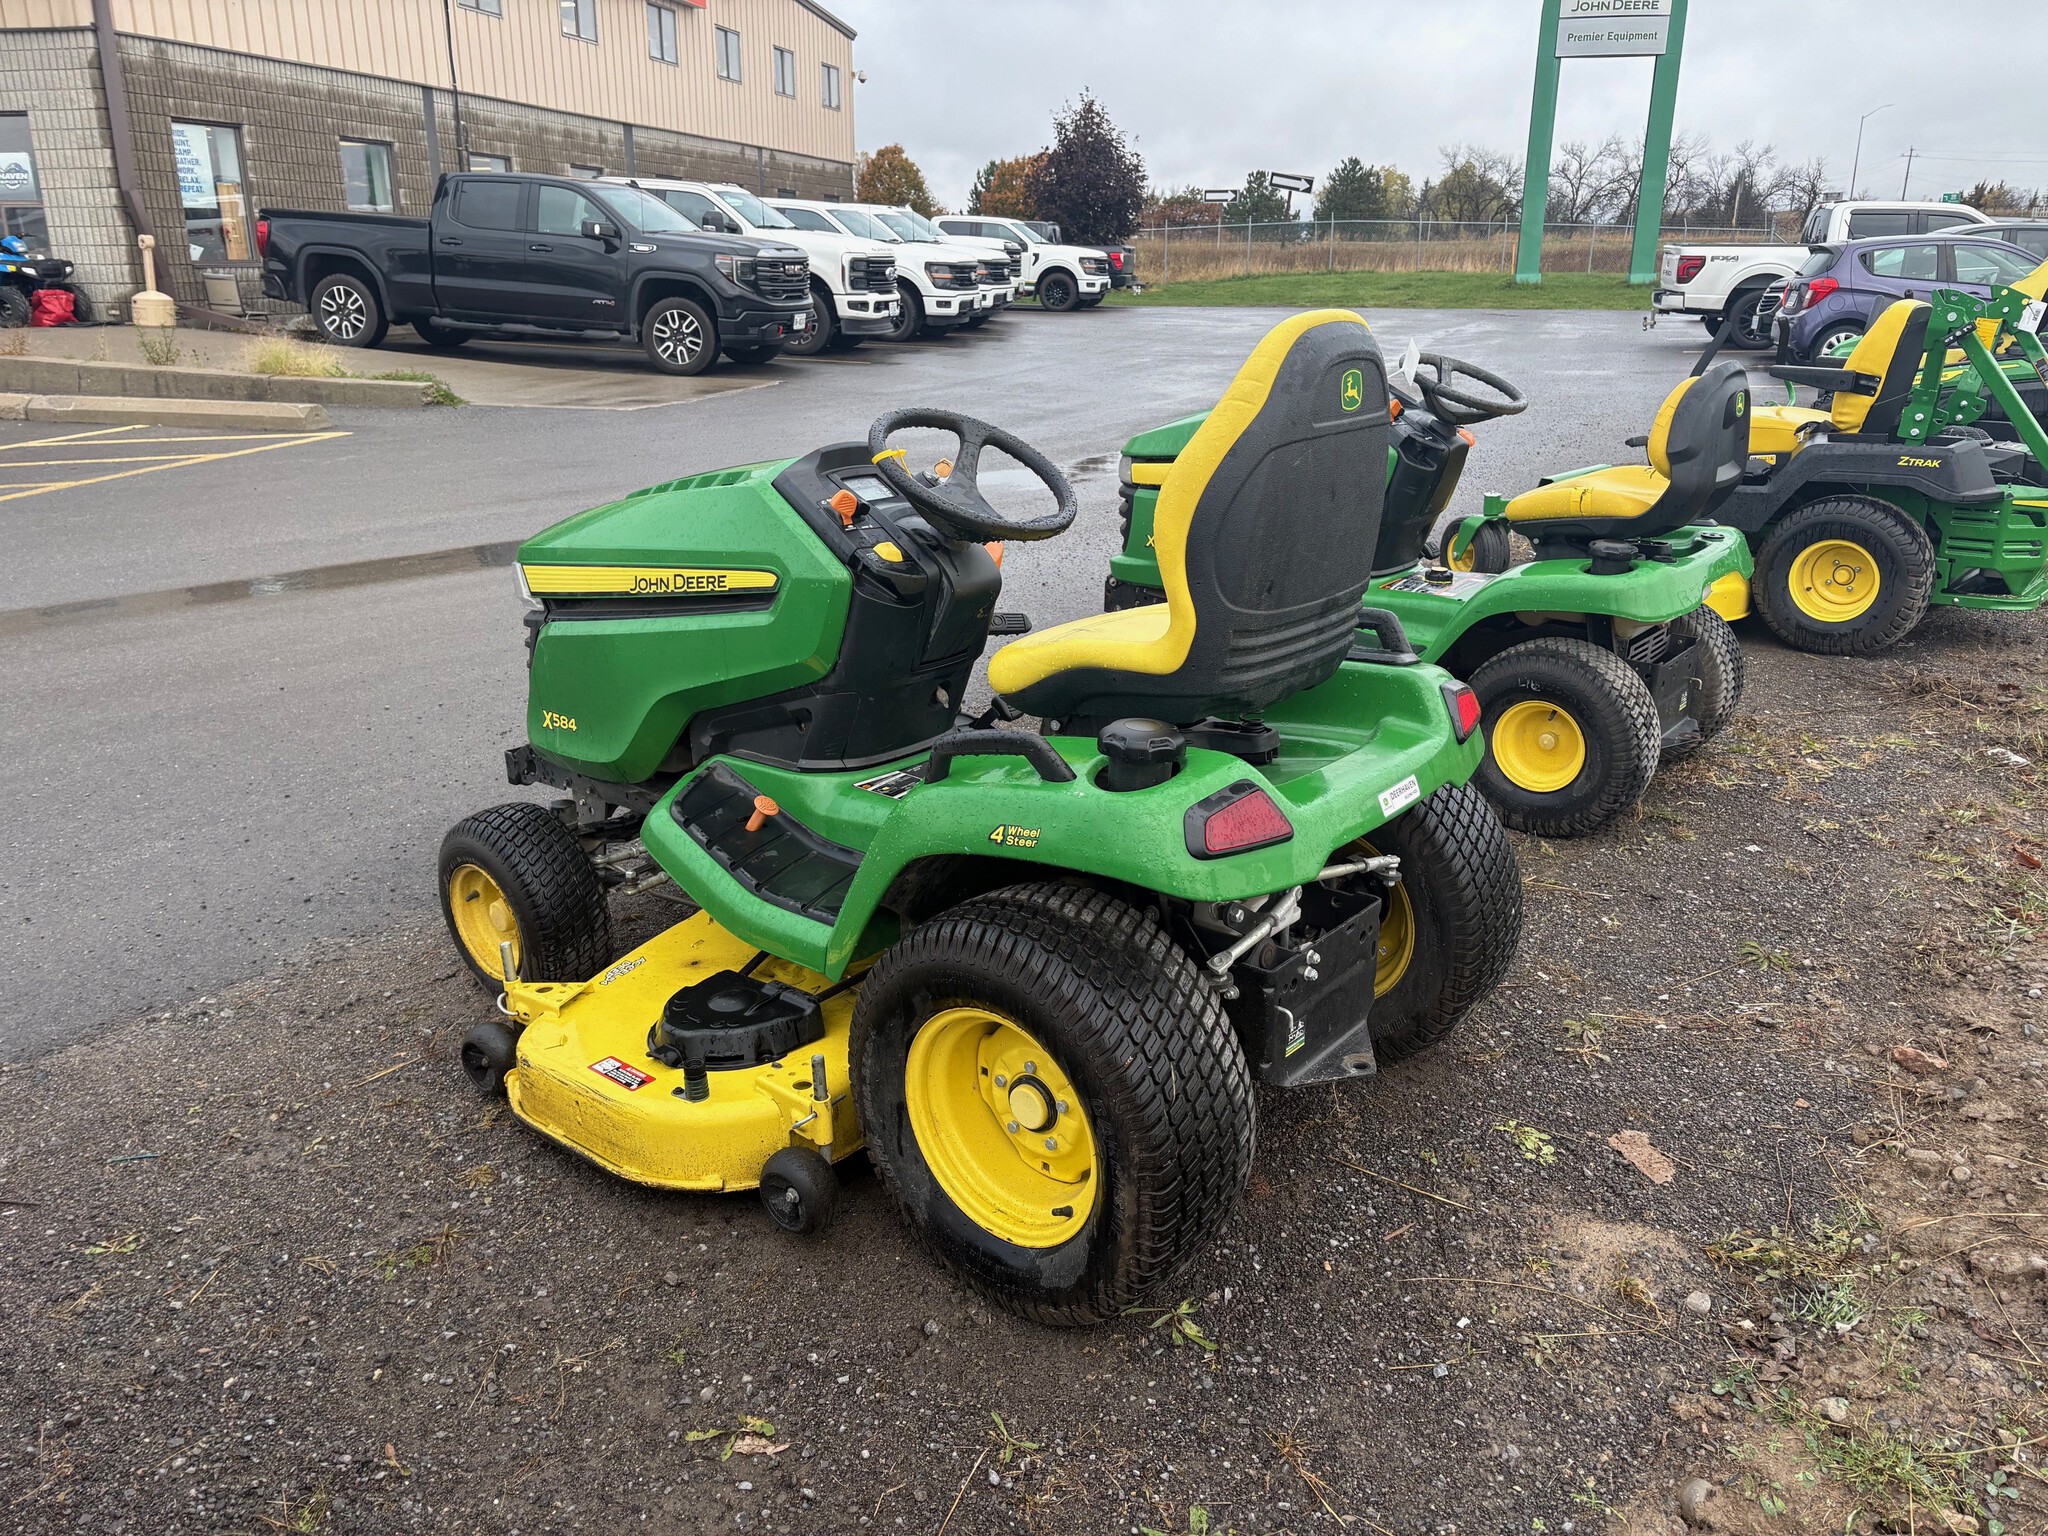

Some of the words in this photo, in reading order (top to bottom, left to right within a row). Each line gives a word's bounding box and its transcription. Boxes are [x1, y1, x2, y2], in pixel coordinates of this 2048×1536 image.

[1571, 0, 1610, 12] JOHN
[1613, 0, 1660, 11] DEERE
[1567, 32, 1604, 42] Premier
[1607, 31, 1658, 43] Equipment
[179, 176, 201, 185] RELAX.
[180, 185, 205, 194] REPEAT.
[1897, 456, 1942, 468] ZTRAK
[630, 575, 670, 592] JOHN
[673, 574, 728, 590] DEERE
[542, 709, 577, 732] X584
[1390, 779, 1417, 800] DEERHAVEN
[989, 824, 1005, 844] 4
[1007, 825, 1041, 838] Wheel
[1005, 835, 1038, 848] Steer
